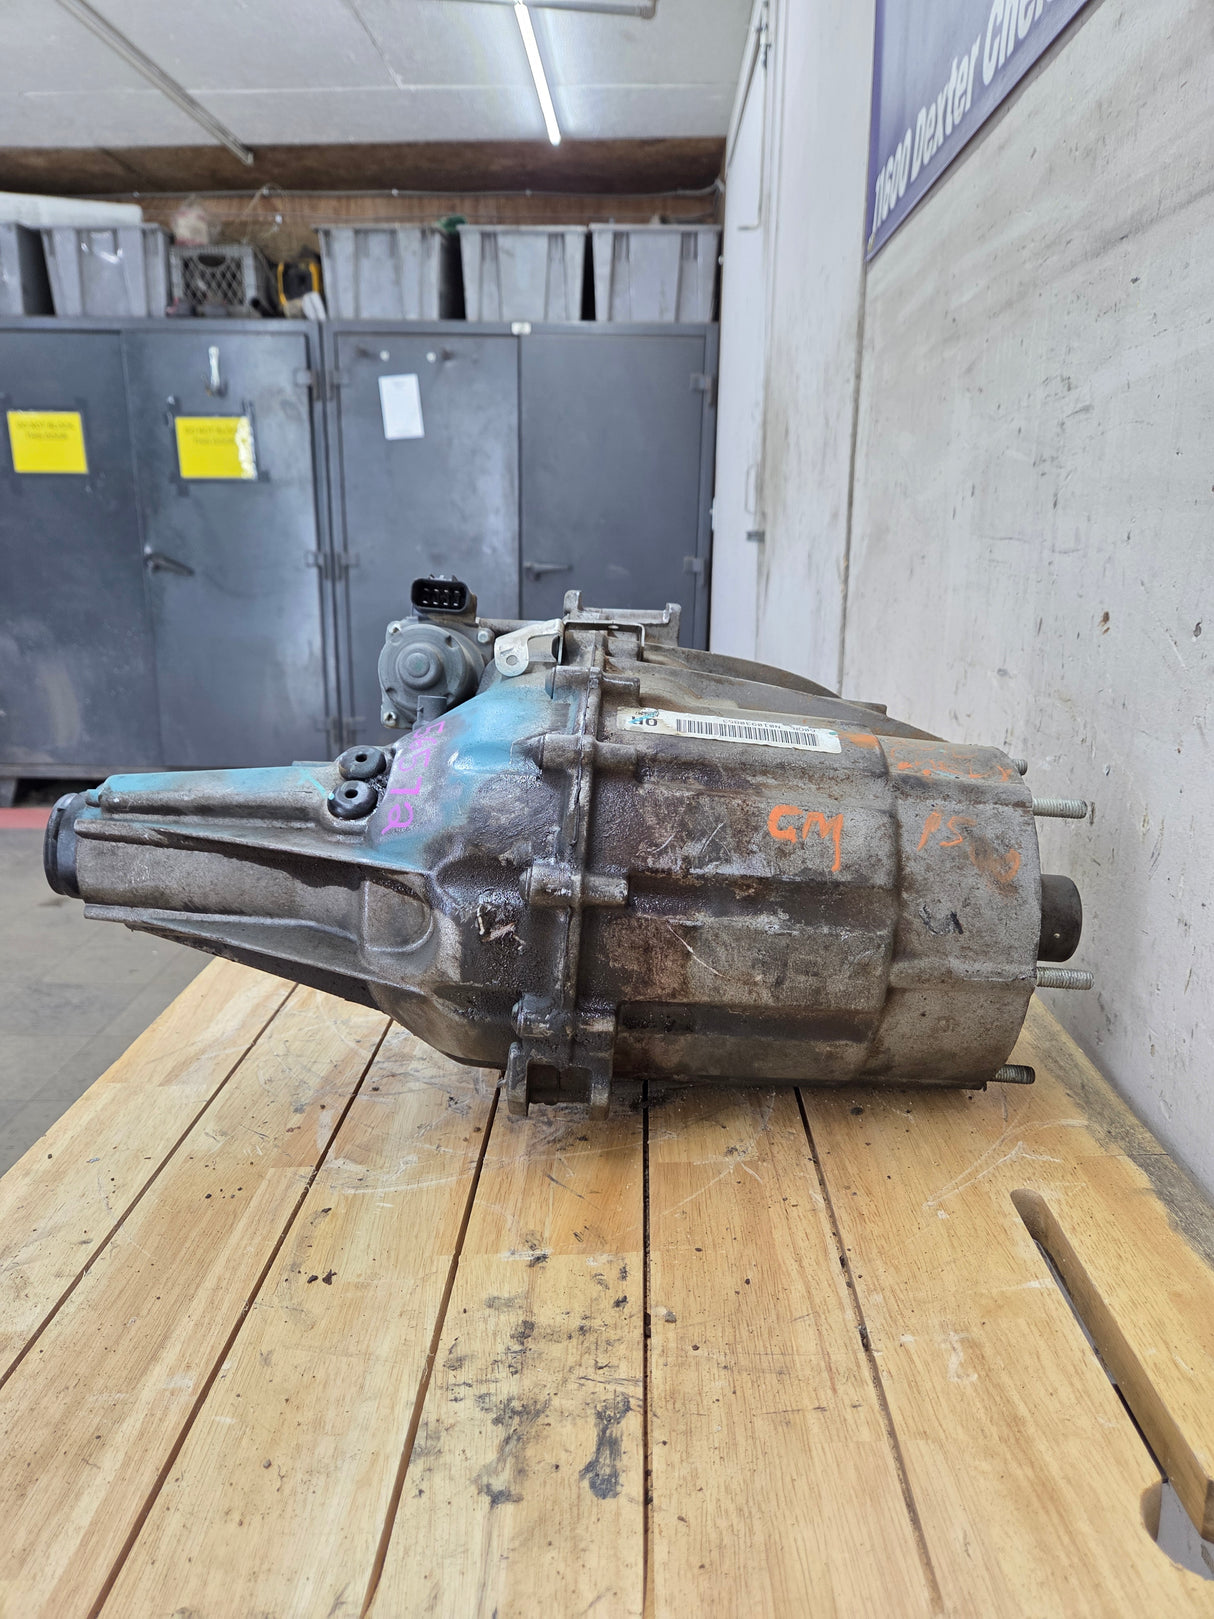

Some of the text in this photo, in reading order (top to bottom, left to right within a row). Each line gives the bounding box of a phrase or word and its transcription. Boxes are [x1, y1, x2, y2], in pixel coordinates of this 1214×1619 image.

[871, 128, 912, 235] 11600
[911, 32, 981, 183] Dexter
[767, 804, 844, 872] GM
